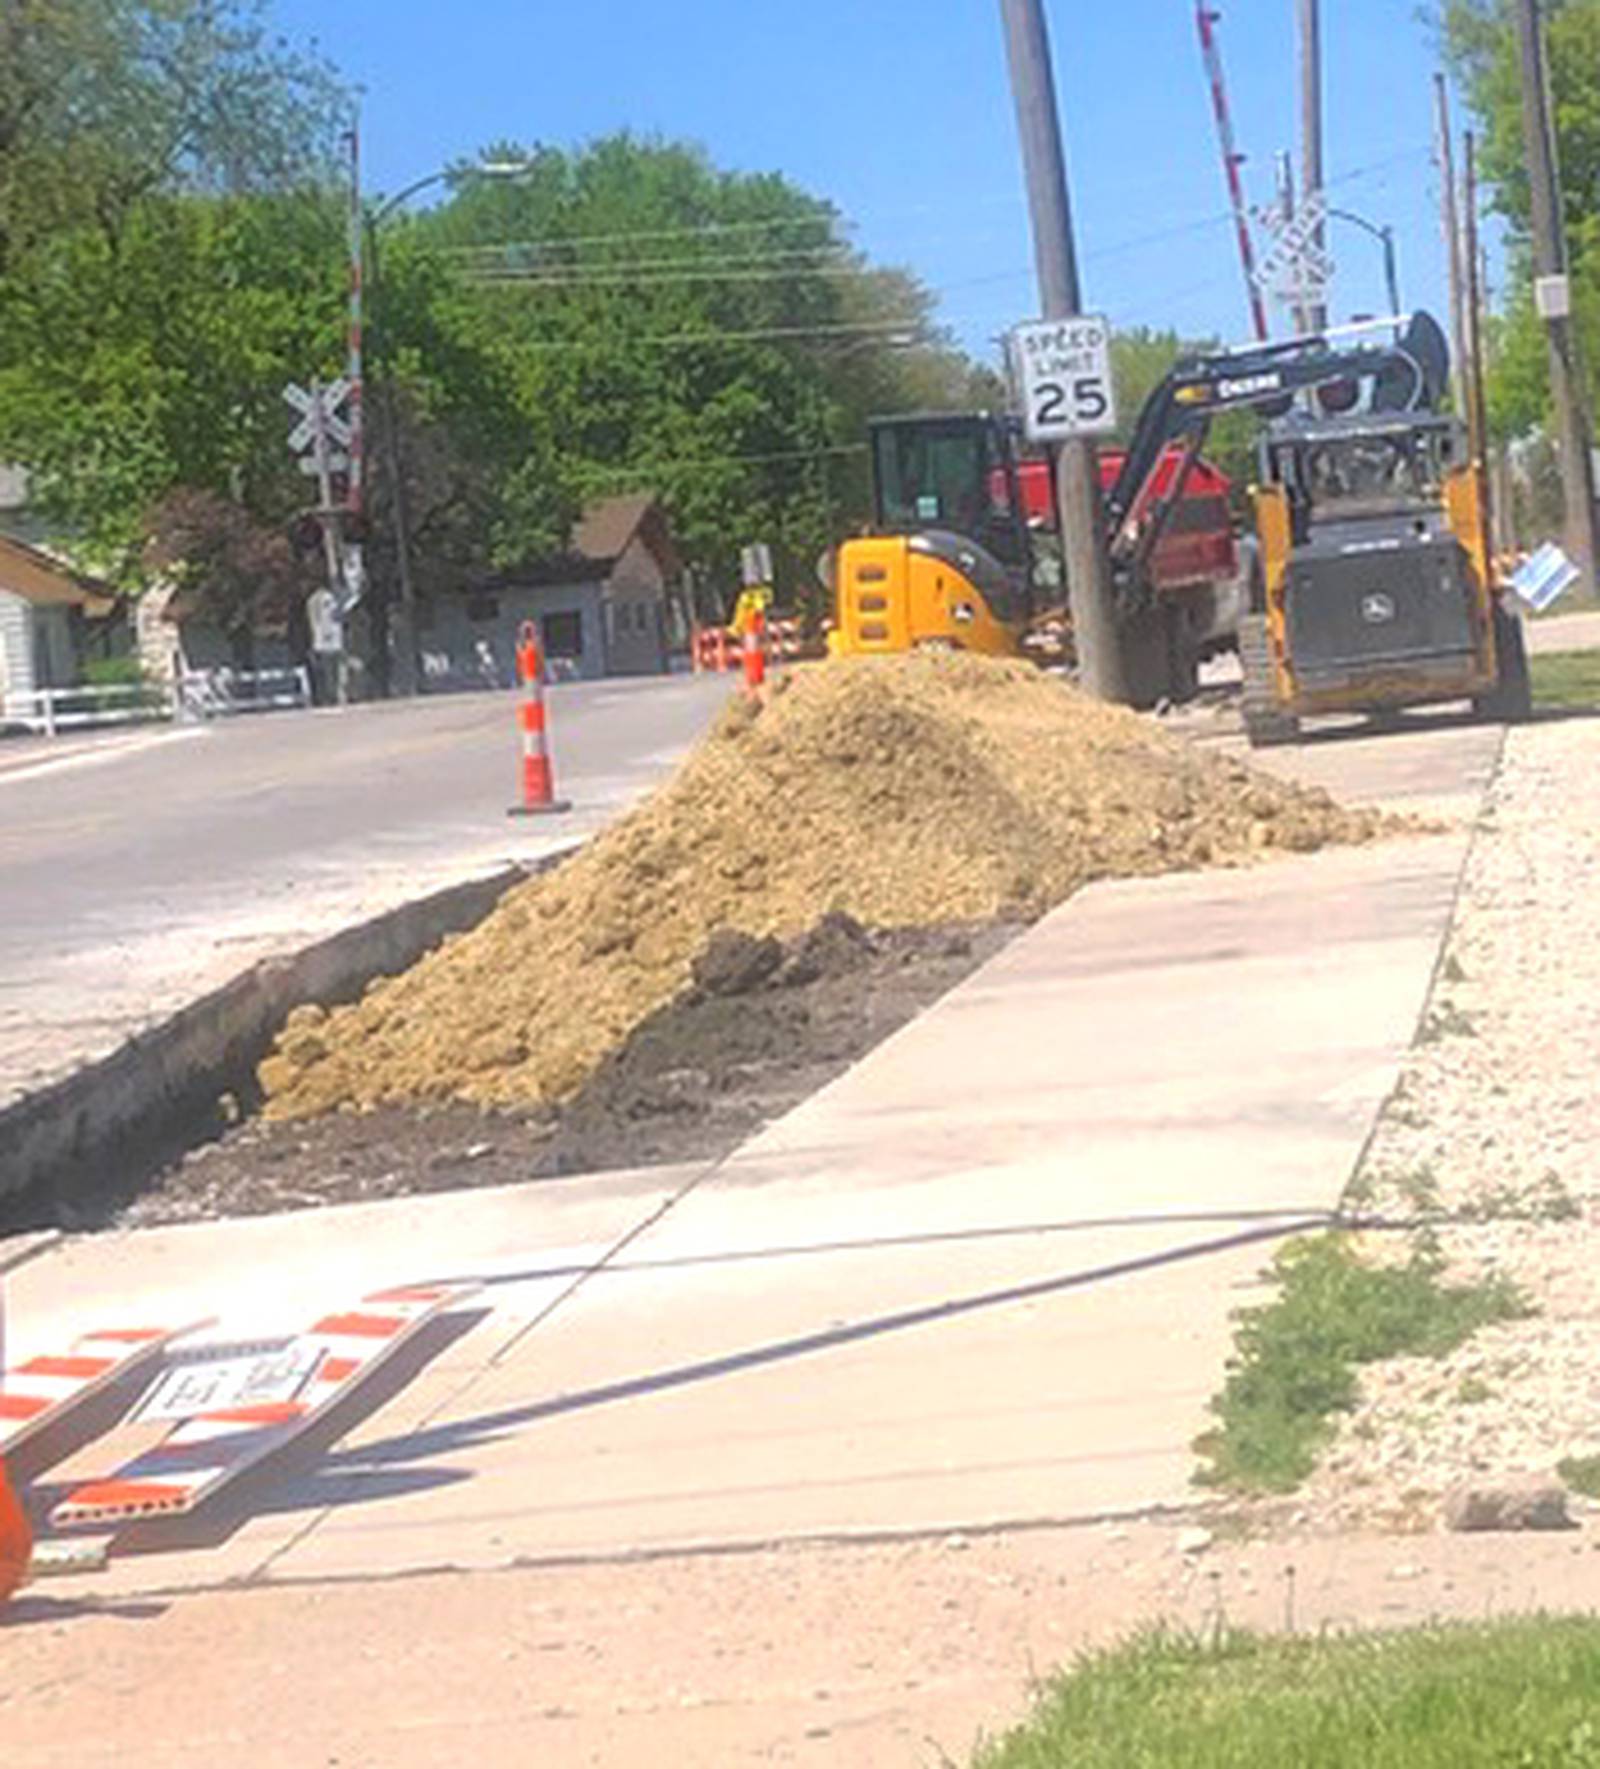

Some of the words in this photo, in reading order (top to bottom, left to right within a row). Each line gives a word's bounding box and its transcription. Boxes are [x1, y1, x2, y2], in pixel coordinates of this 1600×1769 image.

[1026, 327, 1103, 354] SPEED
[1034, 351, 1093, 377] LIMIT
[1033, 378, 1108, 425] 25
